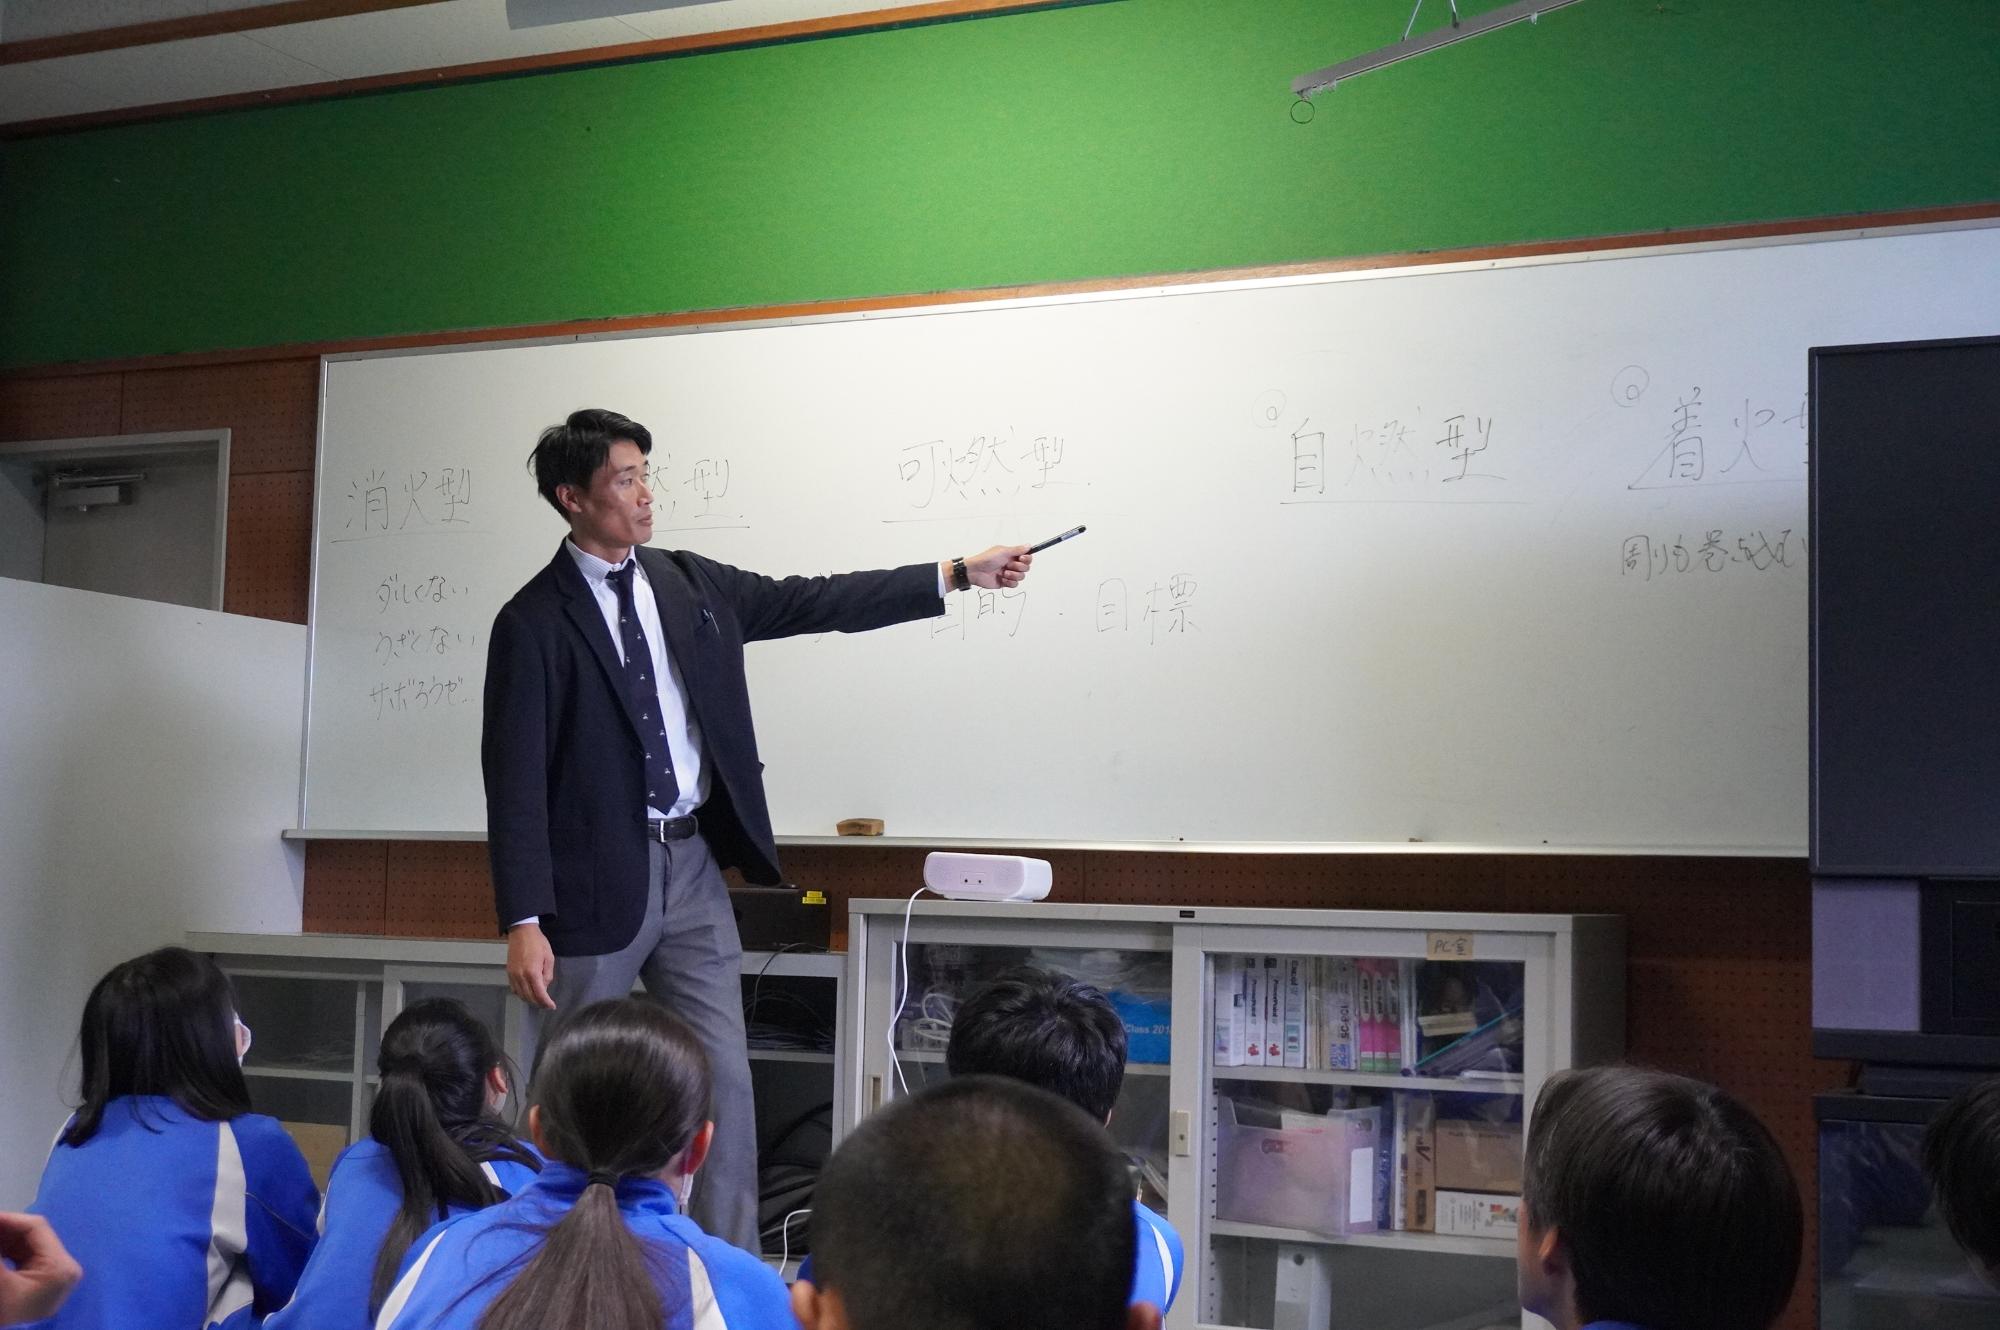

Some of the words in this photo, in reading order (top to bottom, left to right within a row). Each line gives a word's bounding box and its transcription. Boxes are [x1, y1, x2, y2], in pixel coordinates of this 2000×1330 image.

[346, 468, 471, 531] 消火型
[898, 425, 1080, 509] 可燃型
